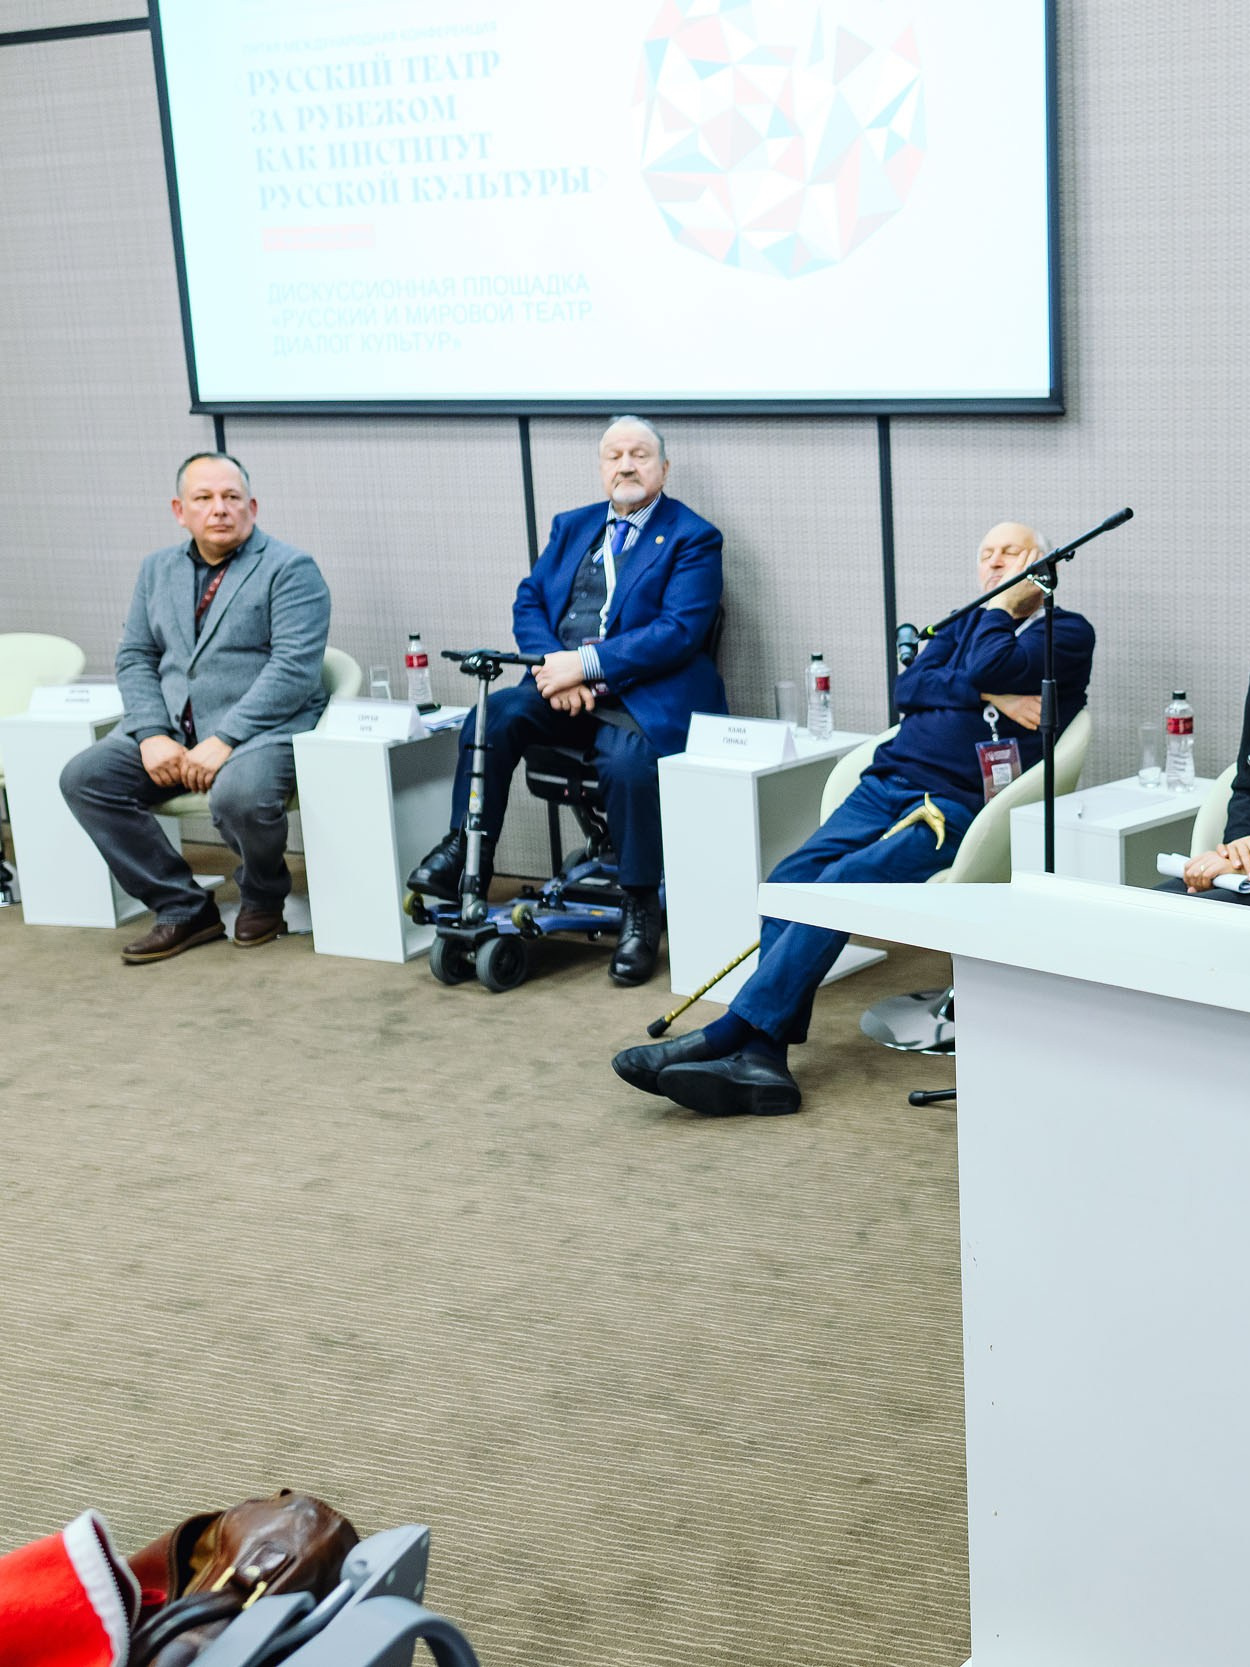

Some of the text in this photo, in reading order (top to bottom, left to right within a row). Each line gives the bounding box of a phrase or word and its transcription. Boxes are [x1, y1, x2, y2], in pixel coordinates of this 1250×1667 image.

[283, 30, 396, 52] МЕЖДУНАРОДНАЯ
[400, 20, 497, 42] КОНФЕРЕНЦИЯ
[247, 50, 501, 96] РУССКИЙ ТЕАТР
[250, 94, 458, 135] ЗА РУБЕЖОМ
[255, 131, 494, 174] КАК ИНСТИТУТ
[258, 171, 401, 211] РУССКОЙ
[267, 271, 590, 305] ДИСКУССИОННАЯ ПЛОЩАДКА
[271, 303, 376, 329] «РУССКИЙ
[384, 305, 399, 324] И
[405, 300, 516, 325] МИРОВОЙ
[271, 330, 462, 358] ДИАЛОГ КУЛЬТУР»
